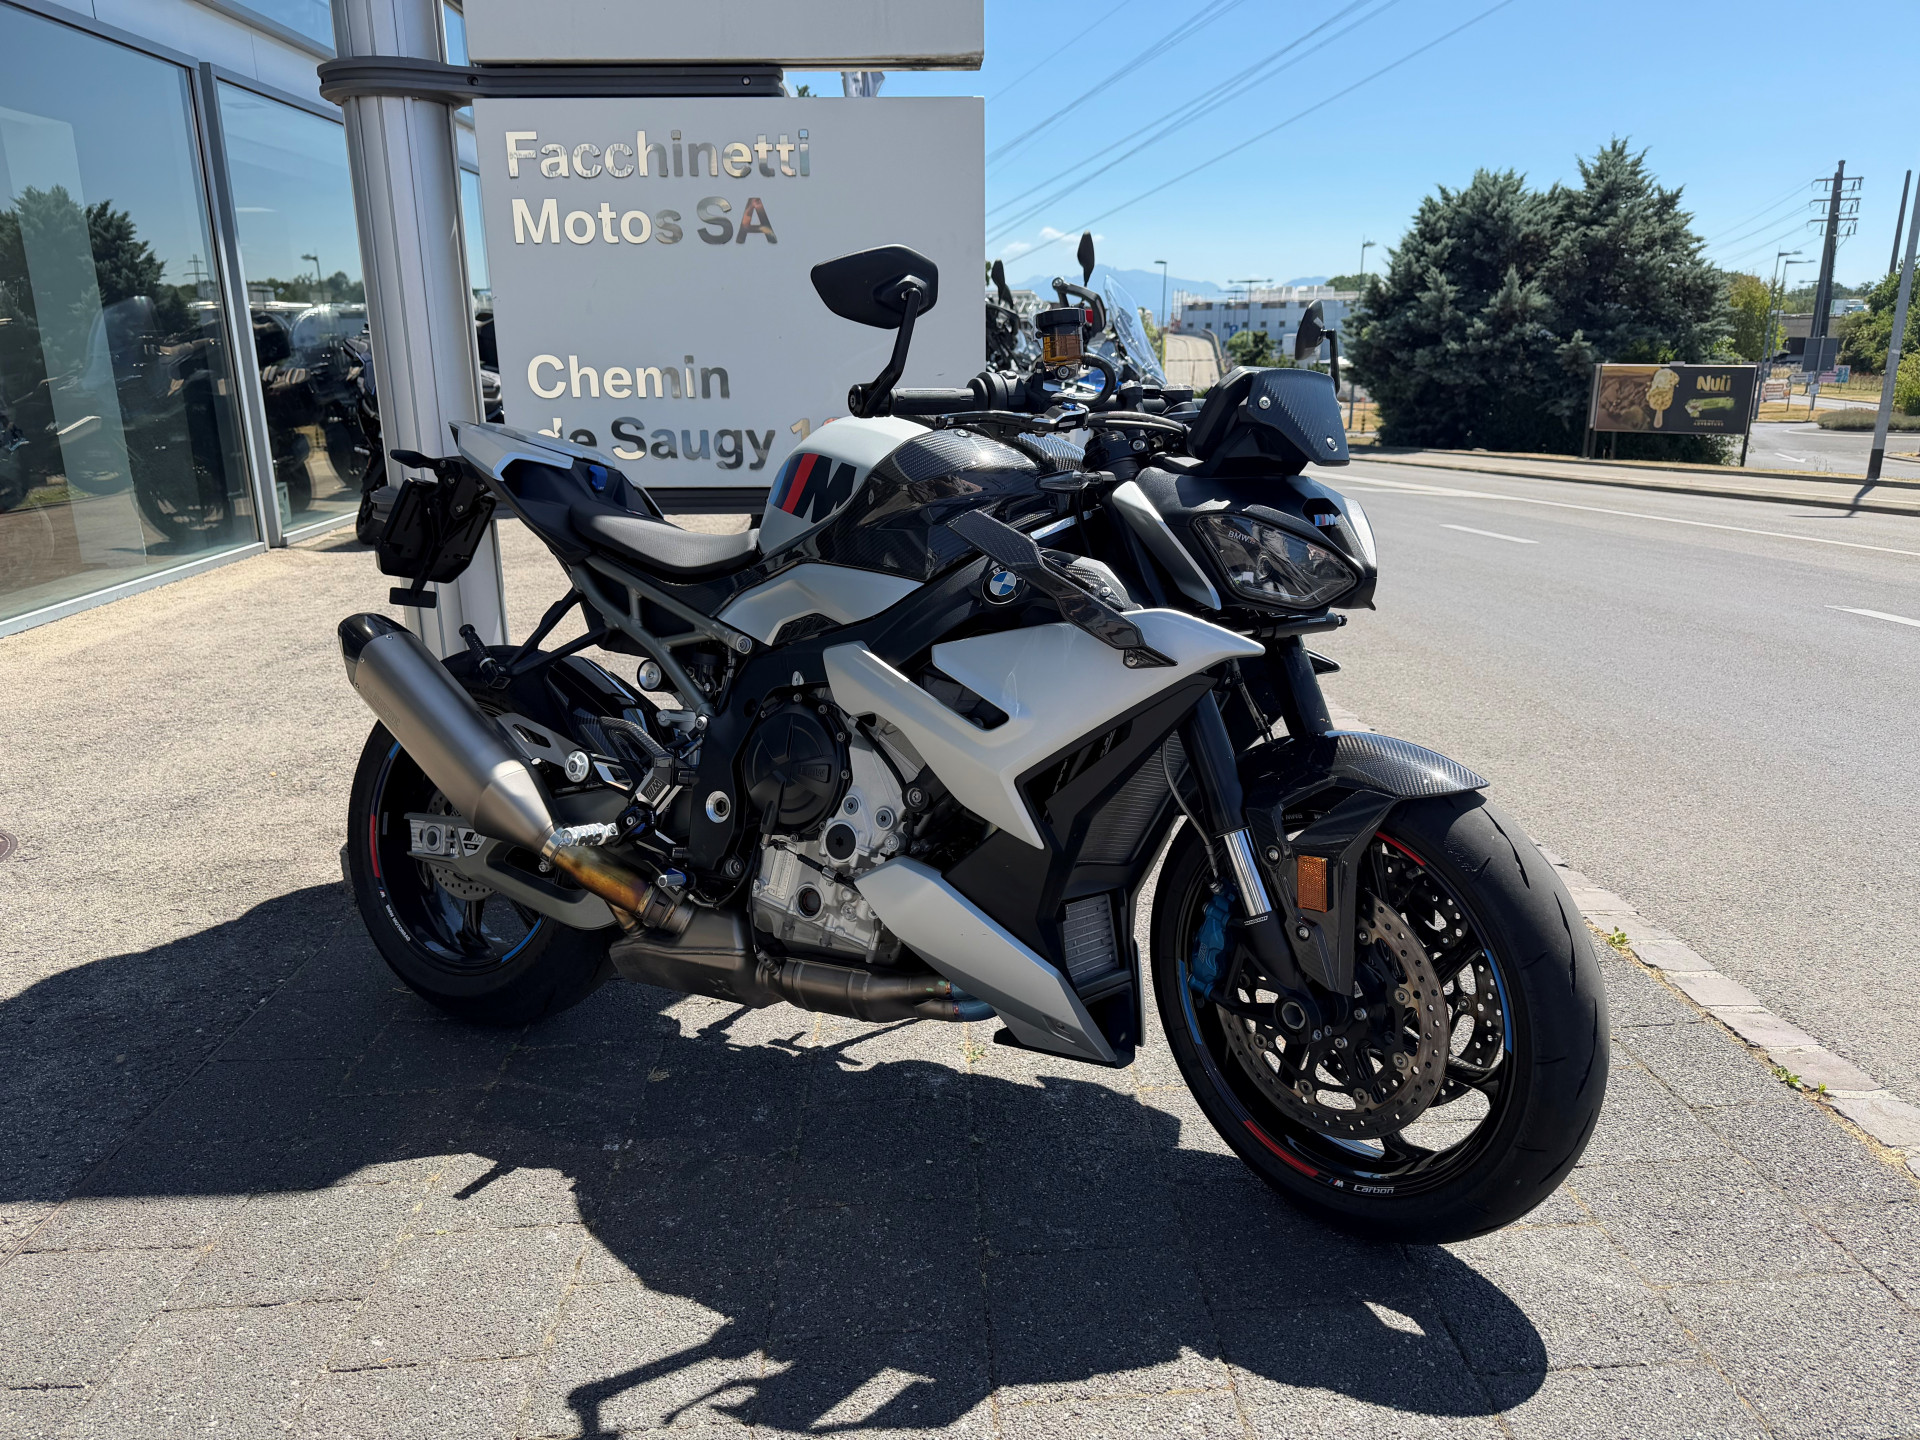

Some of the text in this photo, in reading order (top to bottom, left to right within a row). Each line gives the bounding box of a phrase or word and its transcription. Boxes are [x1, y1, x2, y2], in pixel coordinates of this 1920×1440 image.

[505, 129, 810, 178] Facchinetti
[511, 196, 778, 244] Motos SA
[527, 354, 730, 400] Chemin
[1696, 375, 1731, 391] Nuii
[611, 416, 776, 471] Saugy
[1228, 530, 1249, 542] BMW
[1353, 1184, 1395, 1194] Carbon
